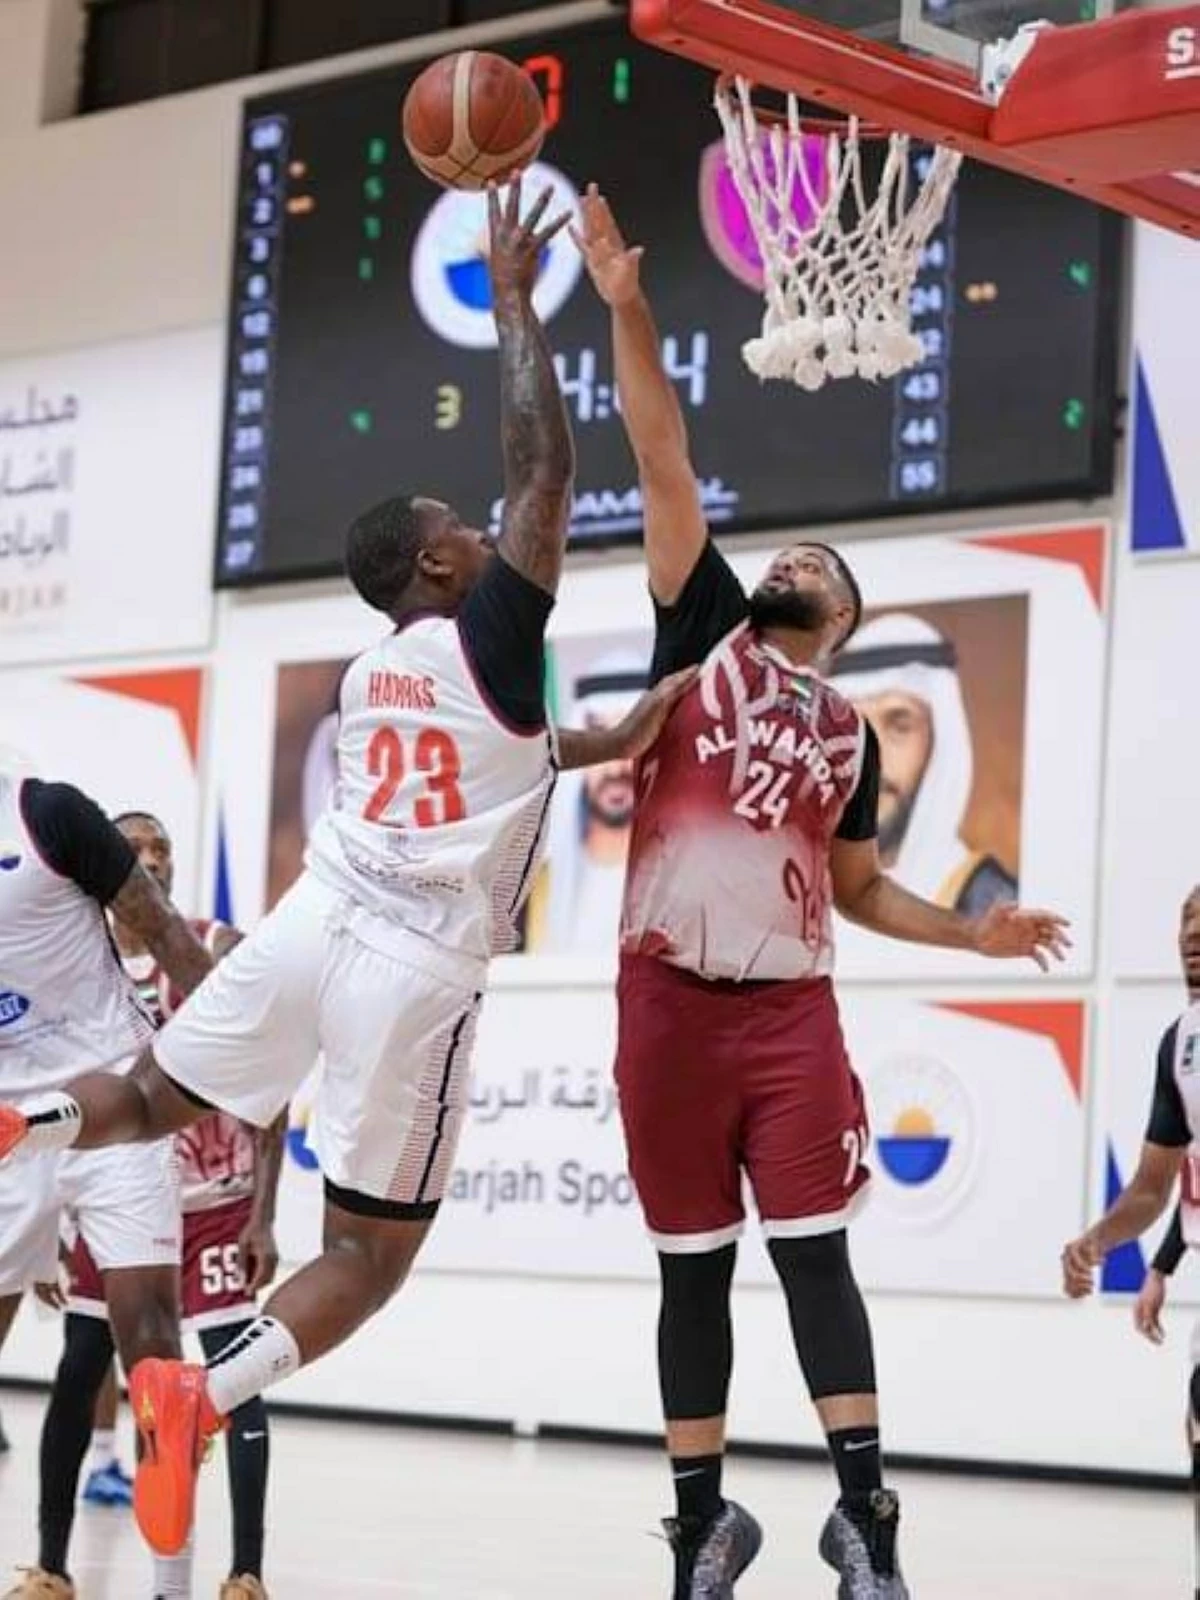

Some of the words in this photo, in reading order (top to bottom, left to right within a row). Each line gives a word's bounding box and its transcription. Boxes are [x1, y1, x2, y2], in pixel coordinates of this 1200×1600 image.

[553, 332, 710, 422] 4:4
[435, 384, 462, 430] 3
[902, 416, 938, 446] 44
[900, 460, 937, 493] 55
[694, 723, 738, 766] AL
[362, 723, 467, 829] 23
[732, 759, 793, 830] 24
[451, 1159, 544, 1215] arjah
[557, 1159, 633, 1217] Spo
